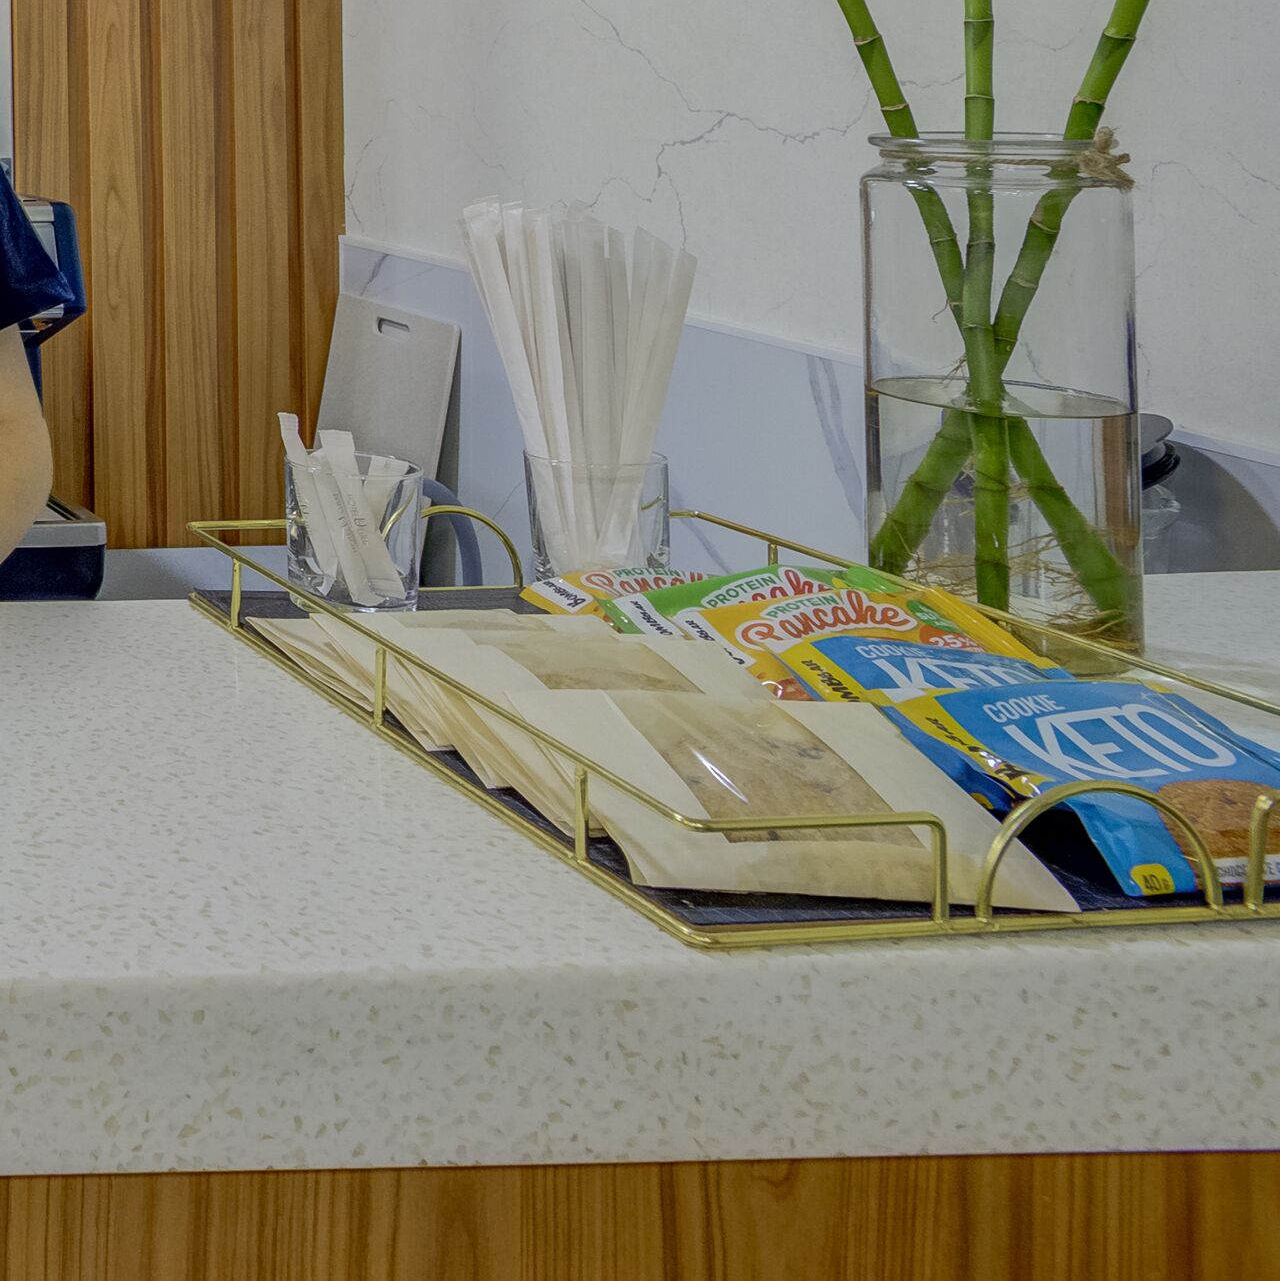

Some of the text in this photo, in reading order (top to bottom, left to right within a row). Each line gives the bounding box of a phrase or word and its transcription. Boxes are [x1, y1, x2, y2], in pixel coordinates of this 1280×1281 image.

[584, 571, 704, 599] Panc
[614, 568, 681, 578] PROTEIN
[706, 575, 778, 608] PROTEIN
[630, 600, 673, 636] OMBBAR
[741, 590, 910, 646] Pancake
[765, 594, 840, 619] PROTEIN
[854, 644, 934, 659] COOKIE
[982, 694, 1067, 723] COOKIE
[1003, 703, 1238, 780] KETO
[1141, 874, 1161, 892] 40
